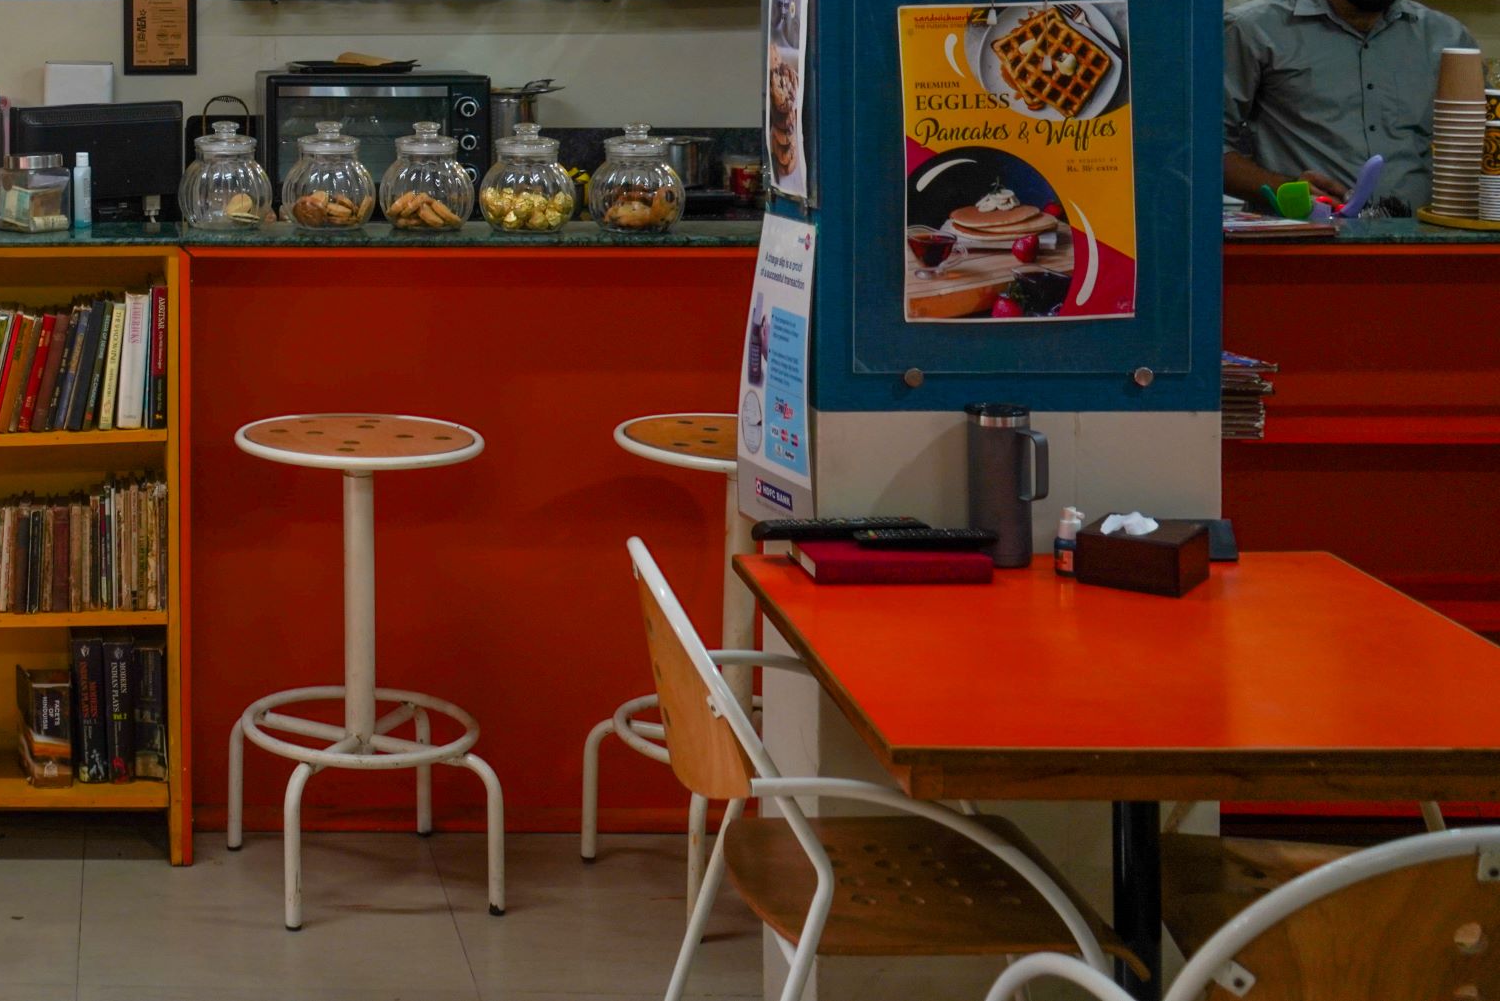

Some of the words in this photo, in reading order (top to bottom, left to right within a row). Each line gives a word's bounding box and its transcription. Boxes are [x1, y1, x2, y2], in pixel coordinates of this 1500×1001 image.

[914, 81, 960, 89] PREMIUM
[915, 93, 1010, 111] EGGLESS
[914, 117, 1009, 146] Pancakes
[1017, 121, 1029, 143] &
[1034, 116, 1118, 152] Waffles
[768, 254, 778, 266] charge
[792, 261, 803, 272] proof
[766, 269, 784, 283] successful
[784, 275, 804, 290] transaction
[114, 311, 122, 322] THE
[130, 302, 142, 344] LIMERICKS
[157, 296, 165, 329] AMRITSAR
[762, 485, 775, 499] HDFC
[776, 491, 790, 507] BANK
[79, 661, 89, 691] INDIAN
[110, 662, 118, 688] INDIAN
[119, 661, 127, 694] MODERN
[80, 692, 89, 718] PLAYS
[111, 689, 120, 712] PLAYS
